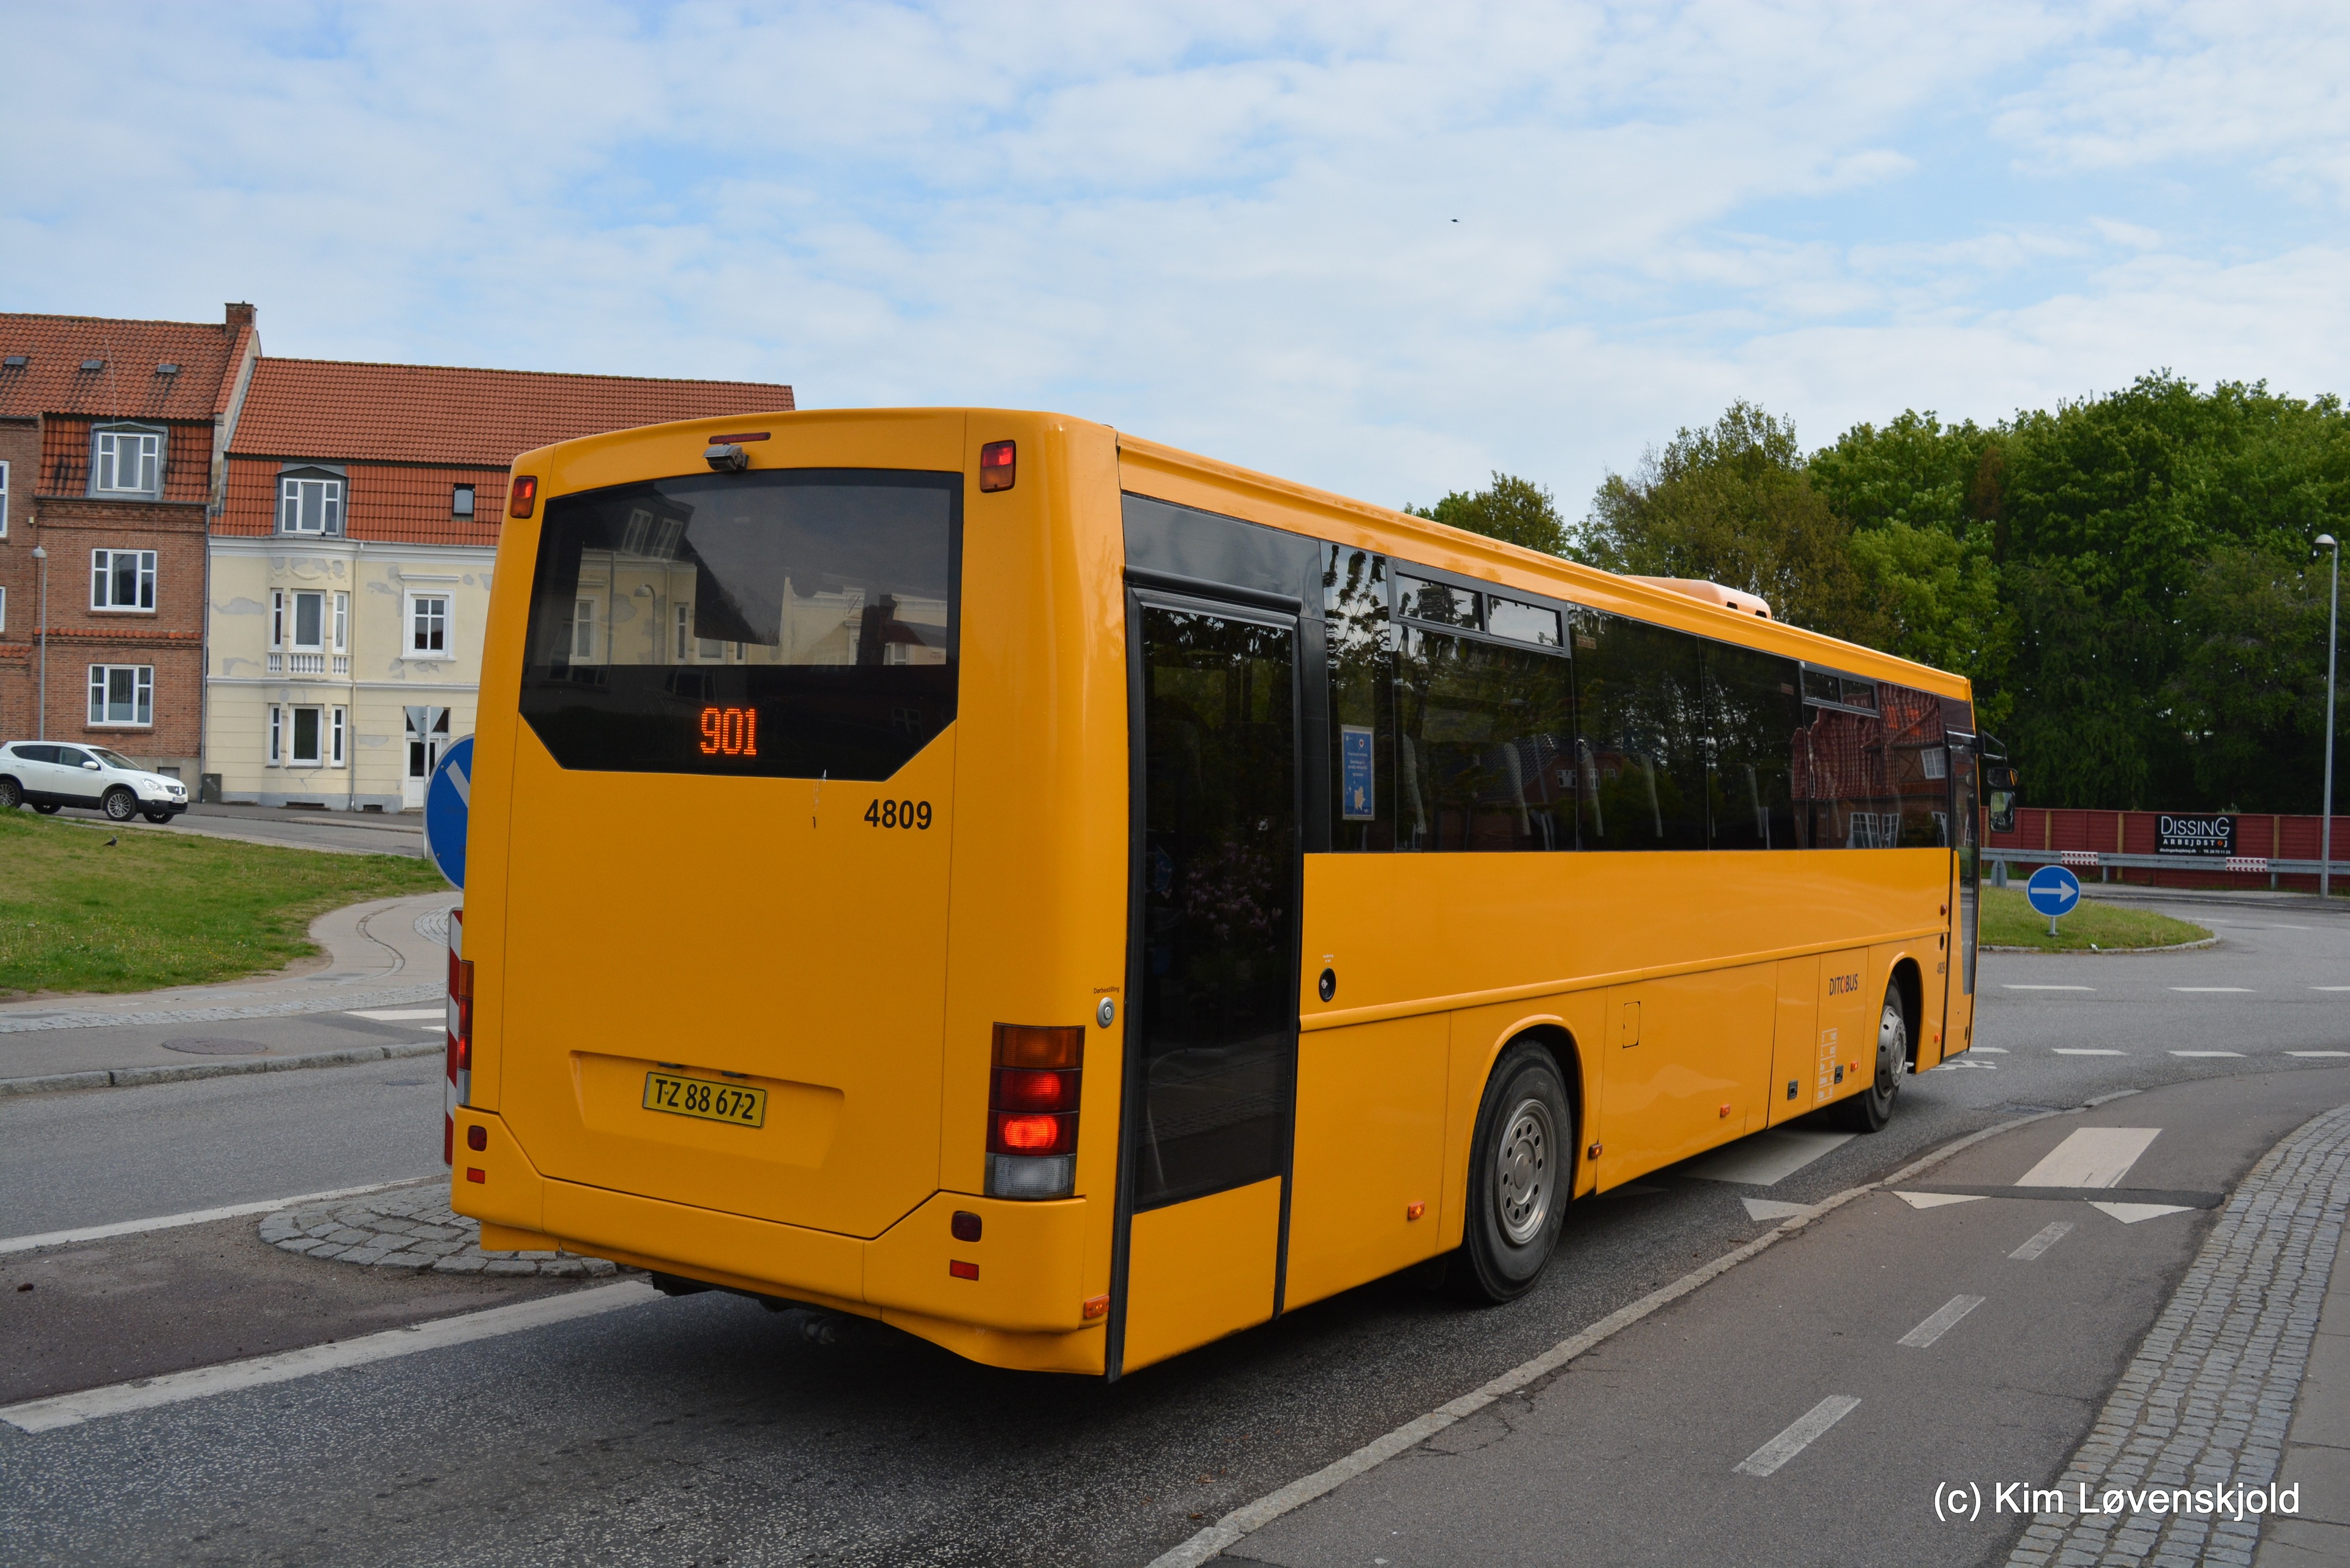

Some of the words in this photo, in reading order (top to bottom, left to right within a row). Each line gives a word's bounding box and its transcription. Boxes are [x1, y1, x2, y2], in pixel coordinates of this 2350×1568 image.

[701, 707, 757, 756] 901
[864, 799, 932, 830] 4809
[2161, 816, 2229, 836] DISSING
[1829, 973, 1858, 996] DITOBUS
[655, 1078, 681, 1107] TZ
[685, 1083, 711, 1113] 88
[715, 1088, 755, 1120] 672
